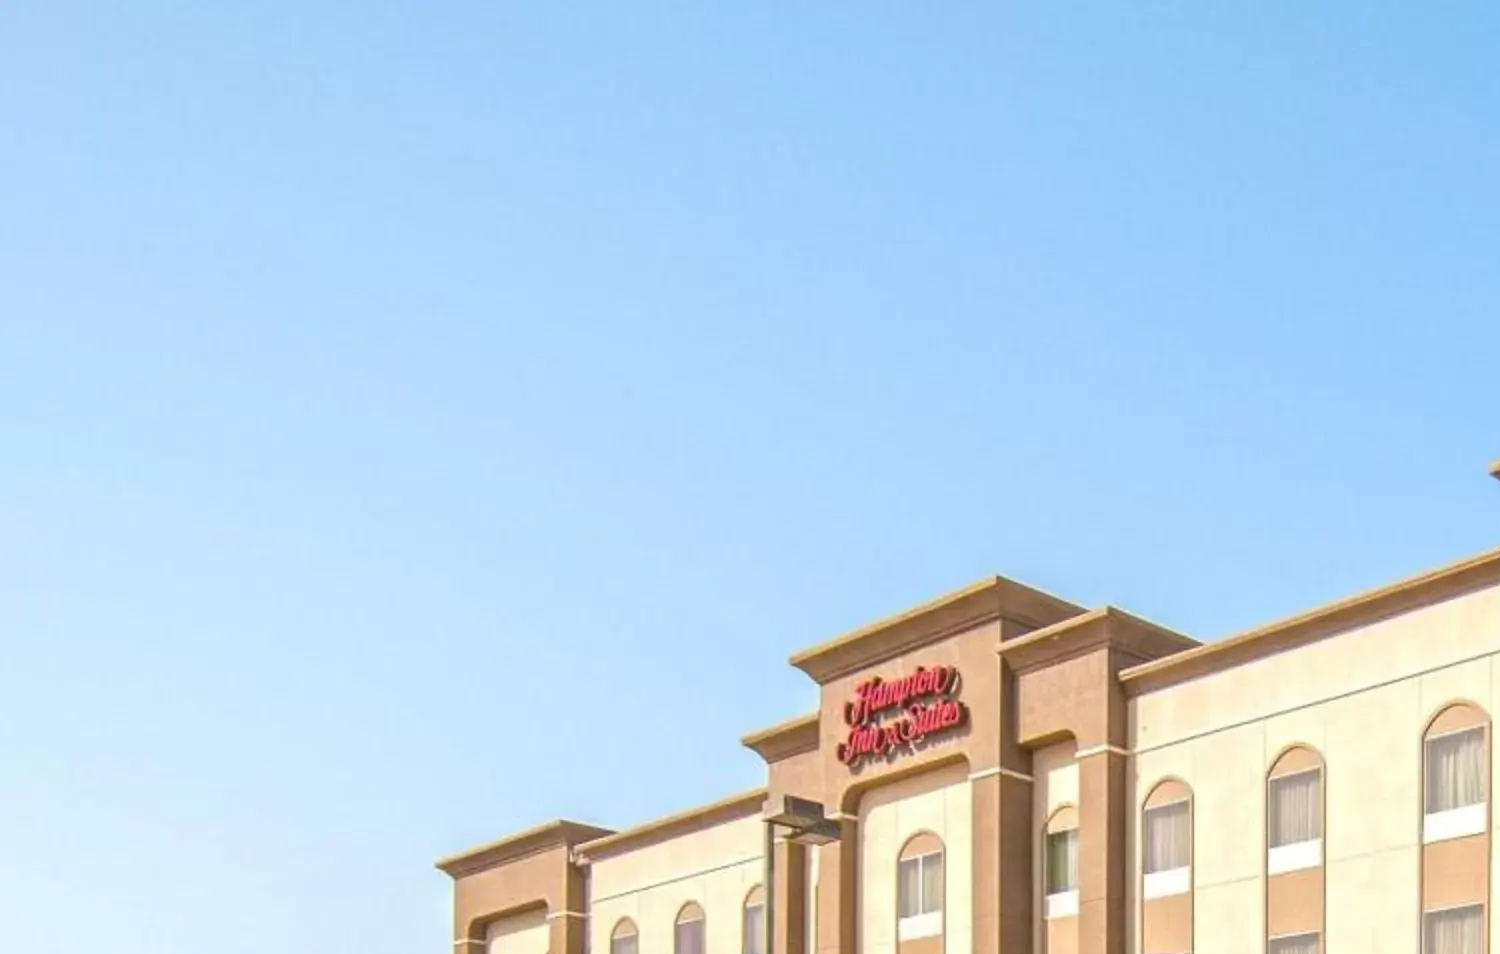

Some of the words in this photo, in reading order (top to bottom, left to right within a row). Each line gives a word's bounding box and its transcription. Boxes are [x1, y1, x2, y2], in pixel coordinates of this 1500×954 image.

[846, 665, 957, 726] Hampton
[840, 723, 886, 765] Inn
[899, 701, 963, 743] Suites
